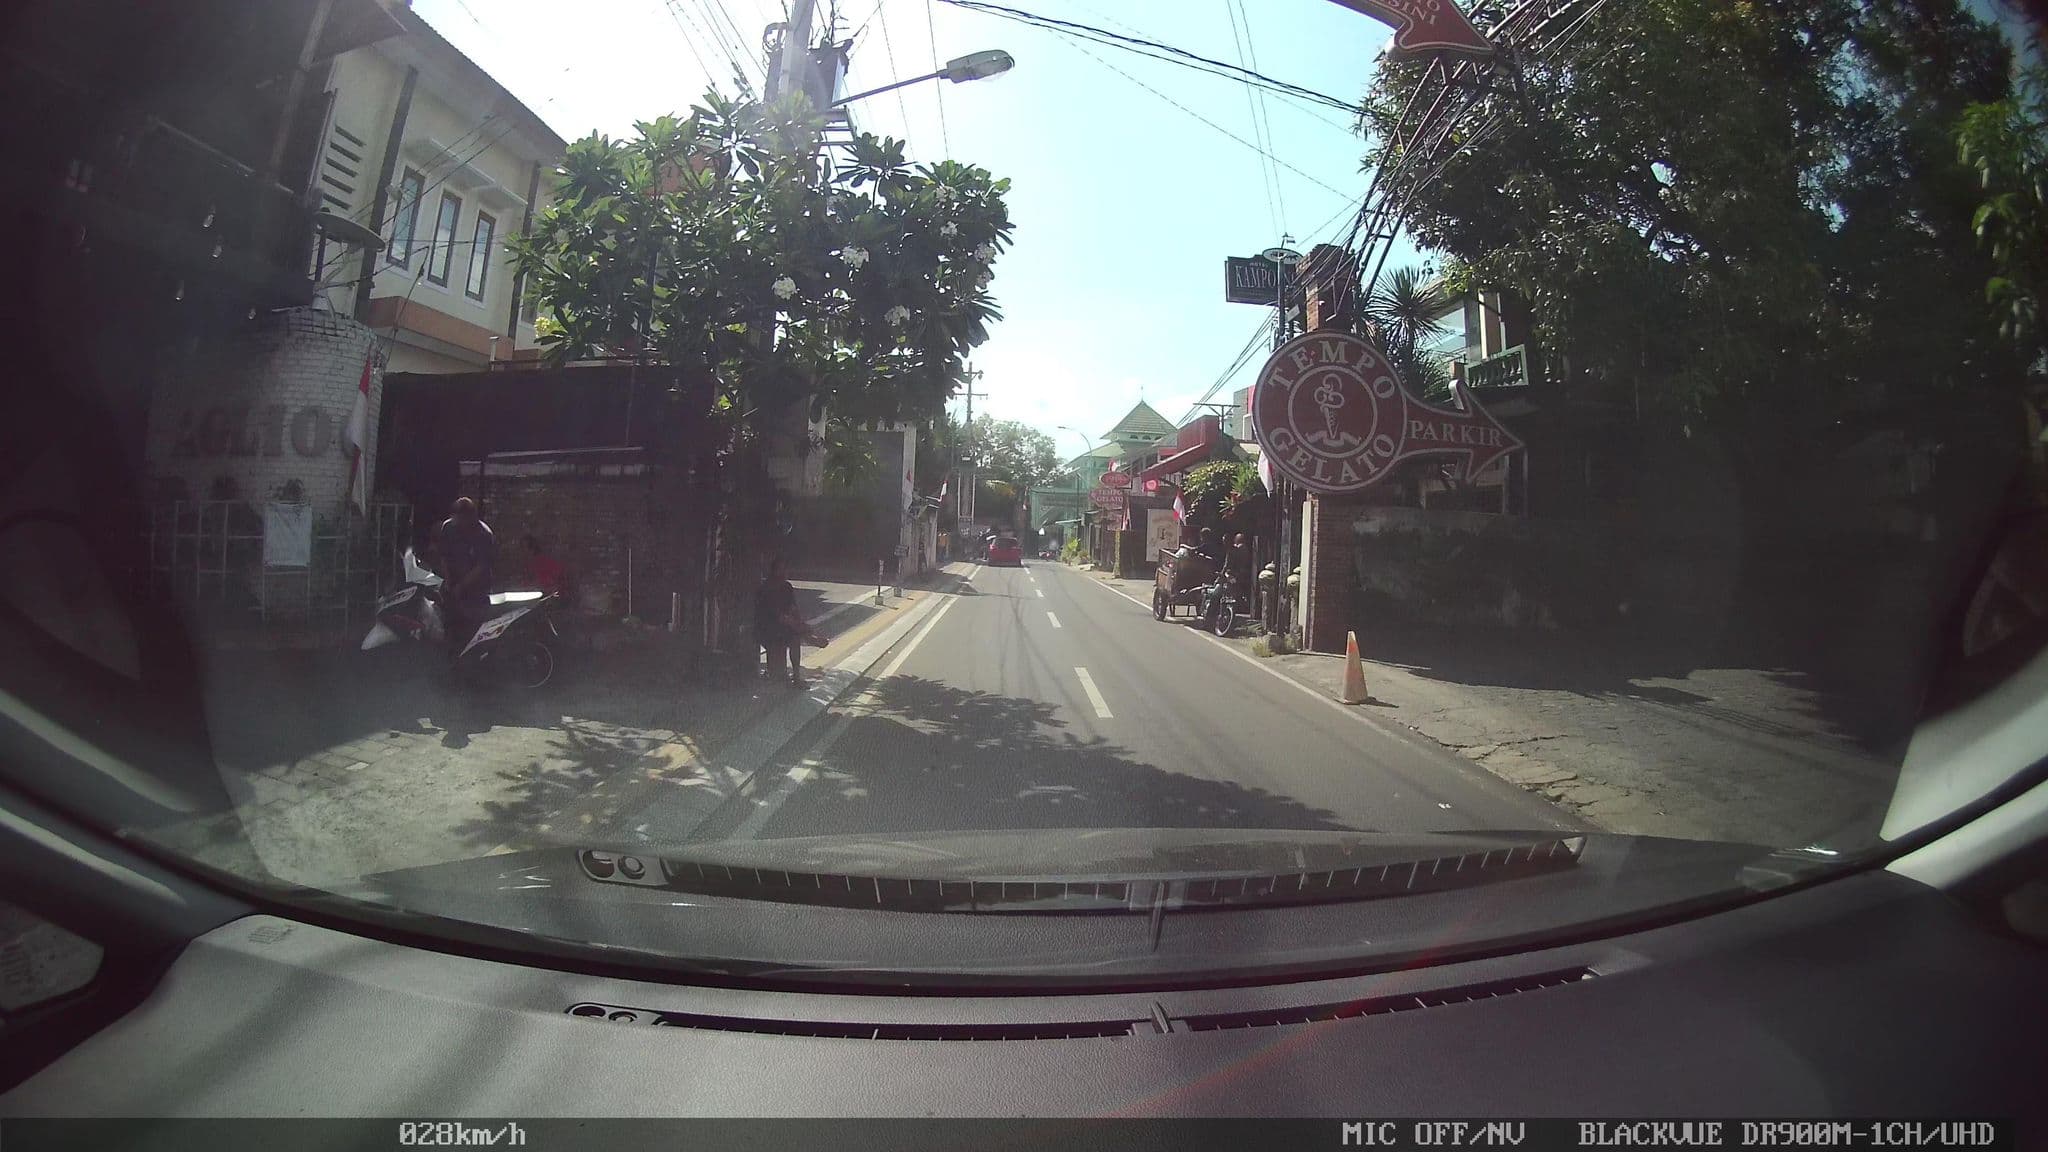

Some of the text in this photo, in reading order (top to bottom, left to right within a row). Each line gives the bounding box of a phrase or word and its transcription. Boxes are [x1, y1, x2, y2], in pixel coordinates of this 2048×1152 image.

[1268, 340, 1396, 399] TEMPO
[1268, 427, 1395, 485] GELATO
[1409, 419, 1504, 448] PARKIR
